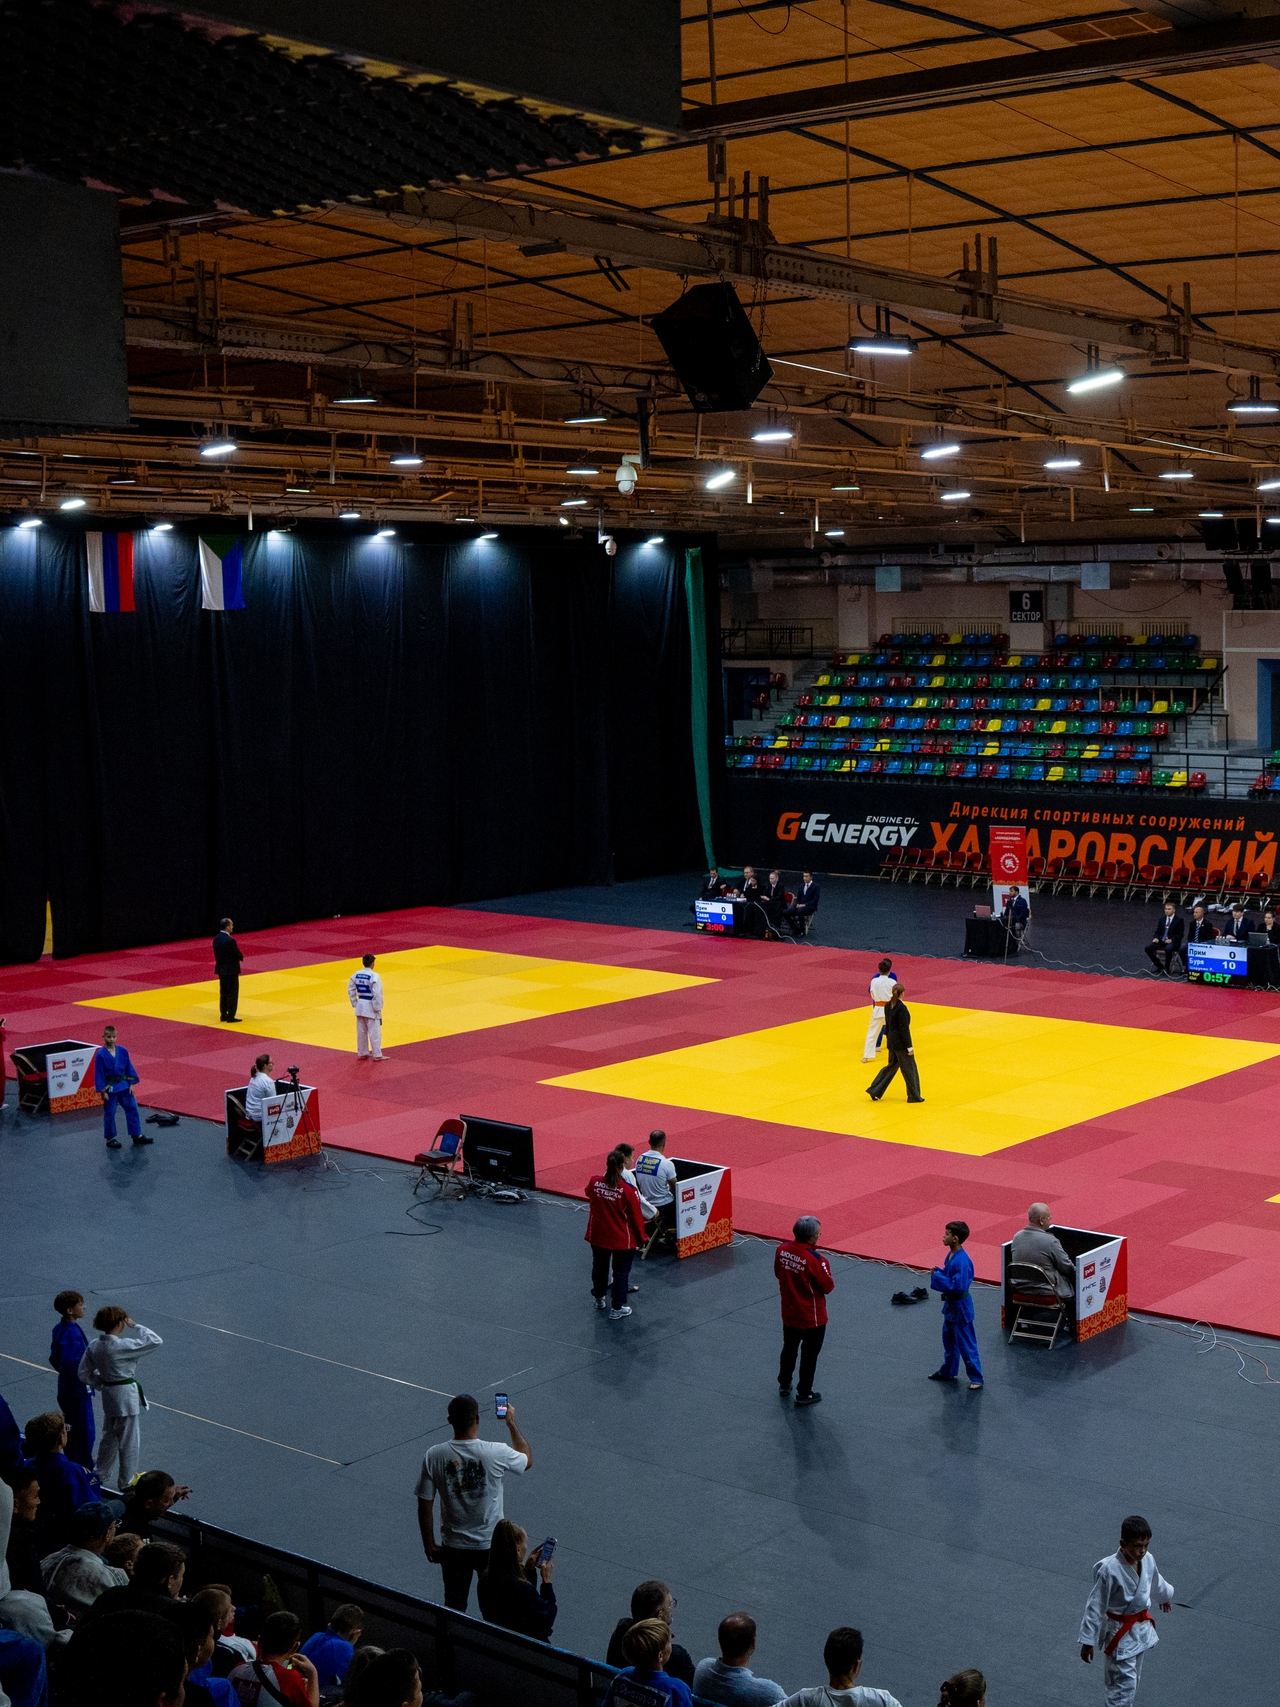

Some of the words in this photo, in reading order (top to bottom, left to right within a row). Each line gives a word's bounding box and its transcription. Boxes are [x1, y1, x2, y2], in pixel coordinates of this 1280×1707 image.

[1022, 592, 1030, 610] 6
[1012, 611, 1041, 621] СЕКТОР
[866, 815, 903, 824] ENGINE
[950, 802, 1028, 820] Дирекция
[1034, 808, 1135, 826] спортивных
[1139, 814, 1246, 832] сооружений
[930, 821, 1278, 888] ХААРОВСКИЙ
[706, 922, 725, 931] 3:00
[1229, 951, 1236, 959] 0
[1222, 961, 1236, 970] 10
[1203, 972, 1231, 984] 0:57
